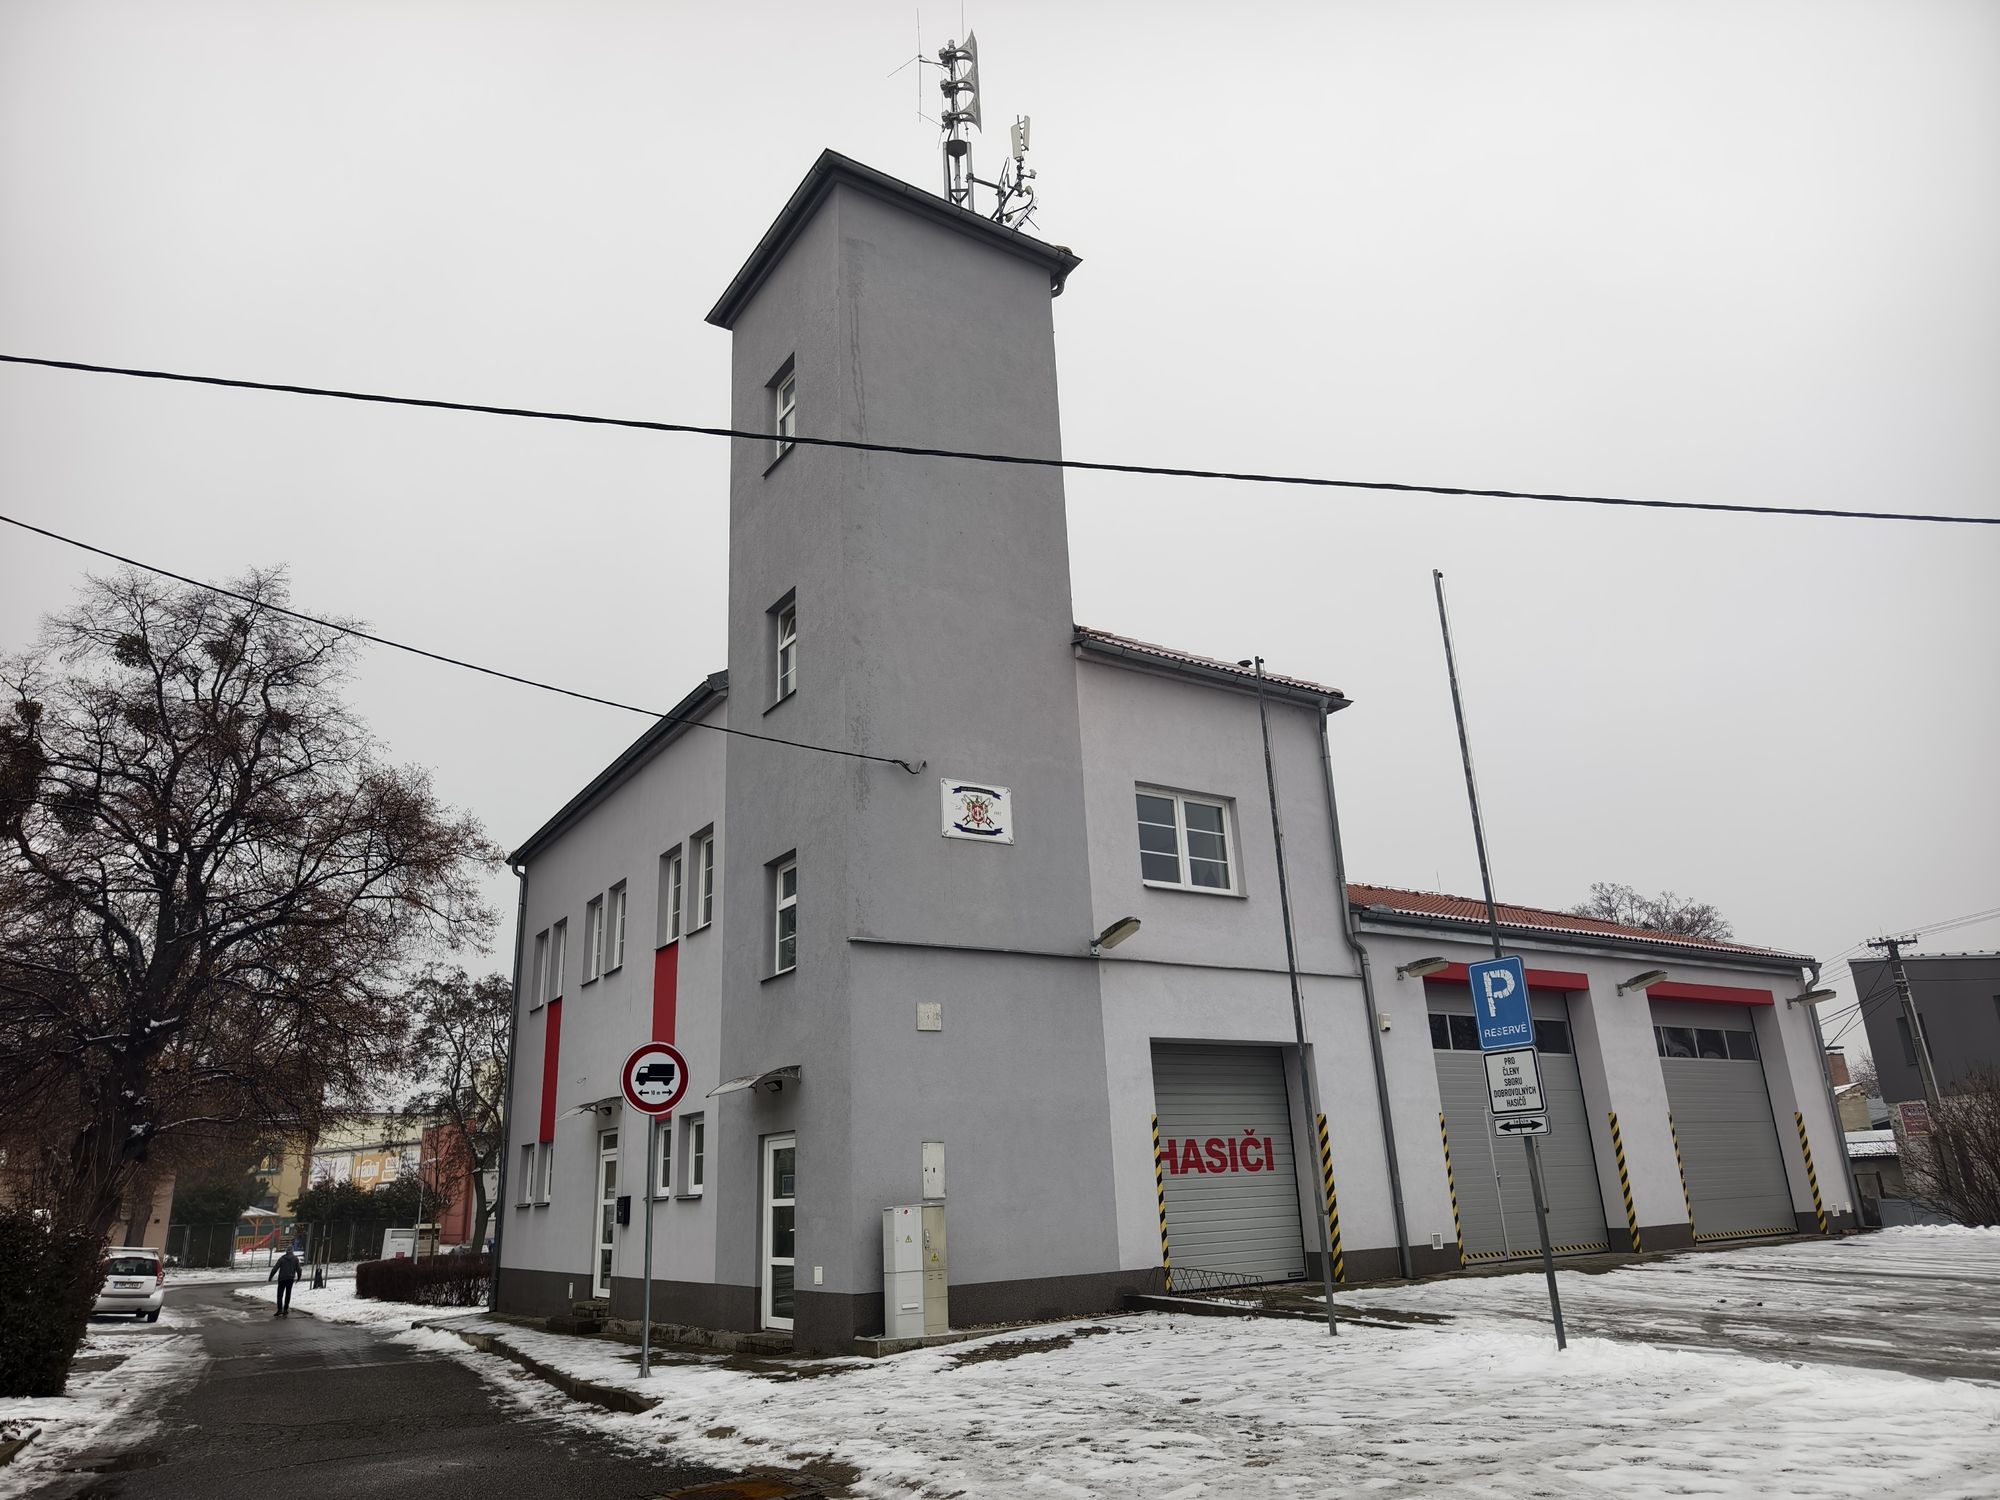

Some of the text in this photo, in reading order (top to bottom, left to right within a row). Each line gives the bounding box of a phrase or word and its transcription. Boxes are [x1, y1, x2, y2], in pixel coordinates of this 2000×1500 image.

[1483, 970, 1515, 1017] P
[1504, 1057, 1515, 1066] PRO
[1502, 1066, 1520, 1076] ČLENY
[1504, 1077, 1523, 1087] SBORU
[1494, 1085, 1537, 1098] DOBROVOLNÝCH
[1506, 1096, 1527, 1107] HASIČŮ
[1160, 1129, 1275, 1175] HASIČI
